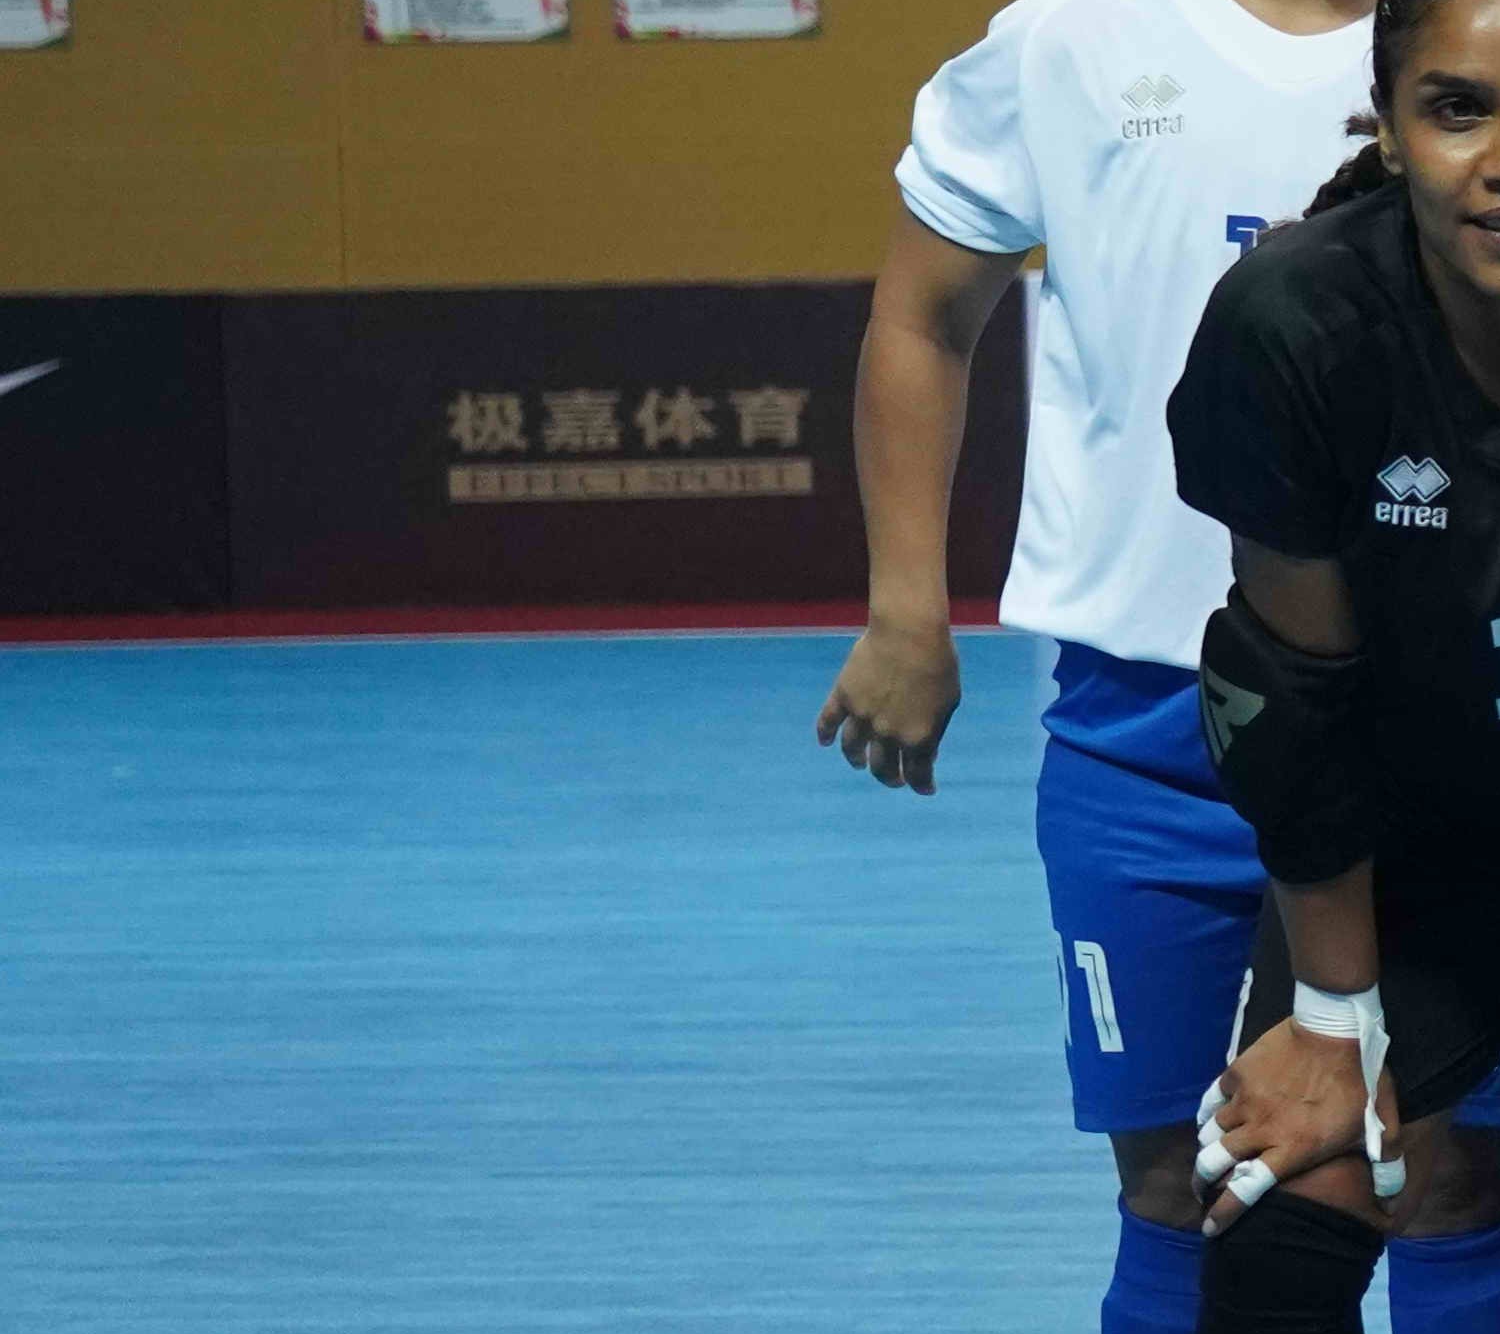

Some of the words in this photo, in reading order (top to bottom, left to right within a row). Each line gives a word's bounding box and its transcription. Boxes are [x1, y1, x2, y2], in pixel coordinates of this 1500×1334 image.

[447, 387, 811, 454] 极嘉体育
[1374, 500, 1449, 530] errea
